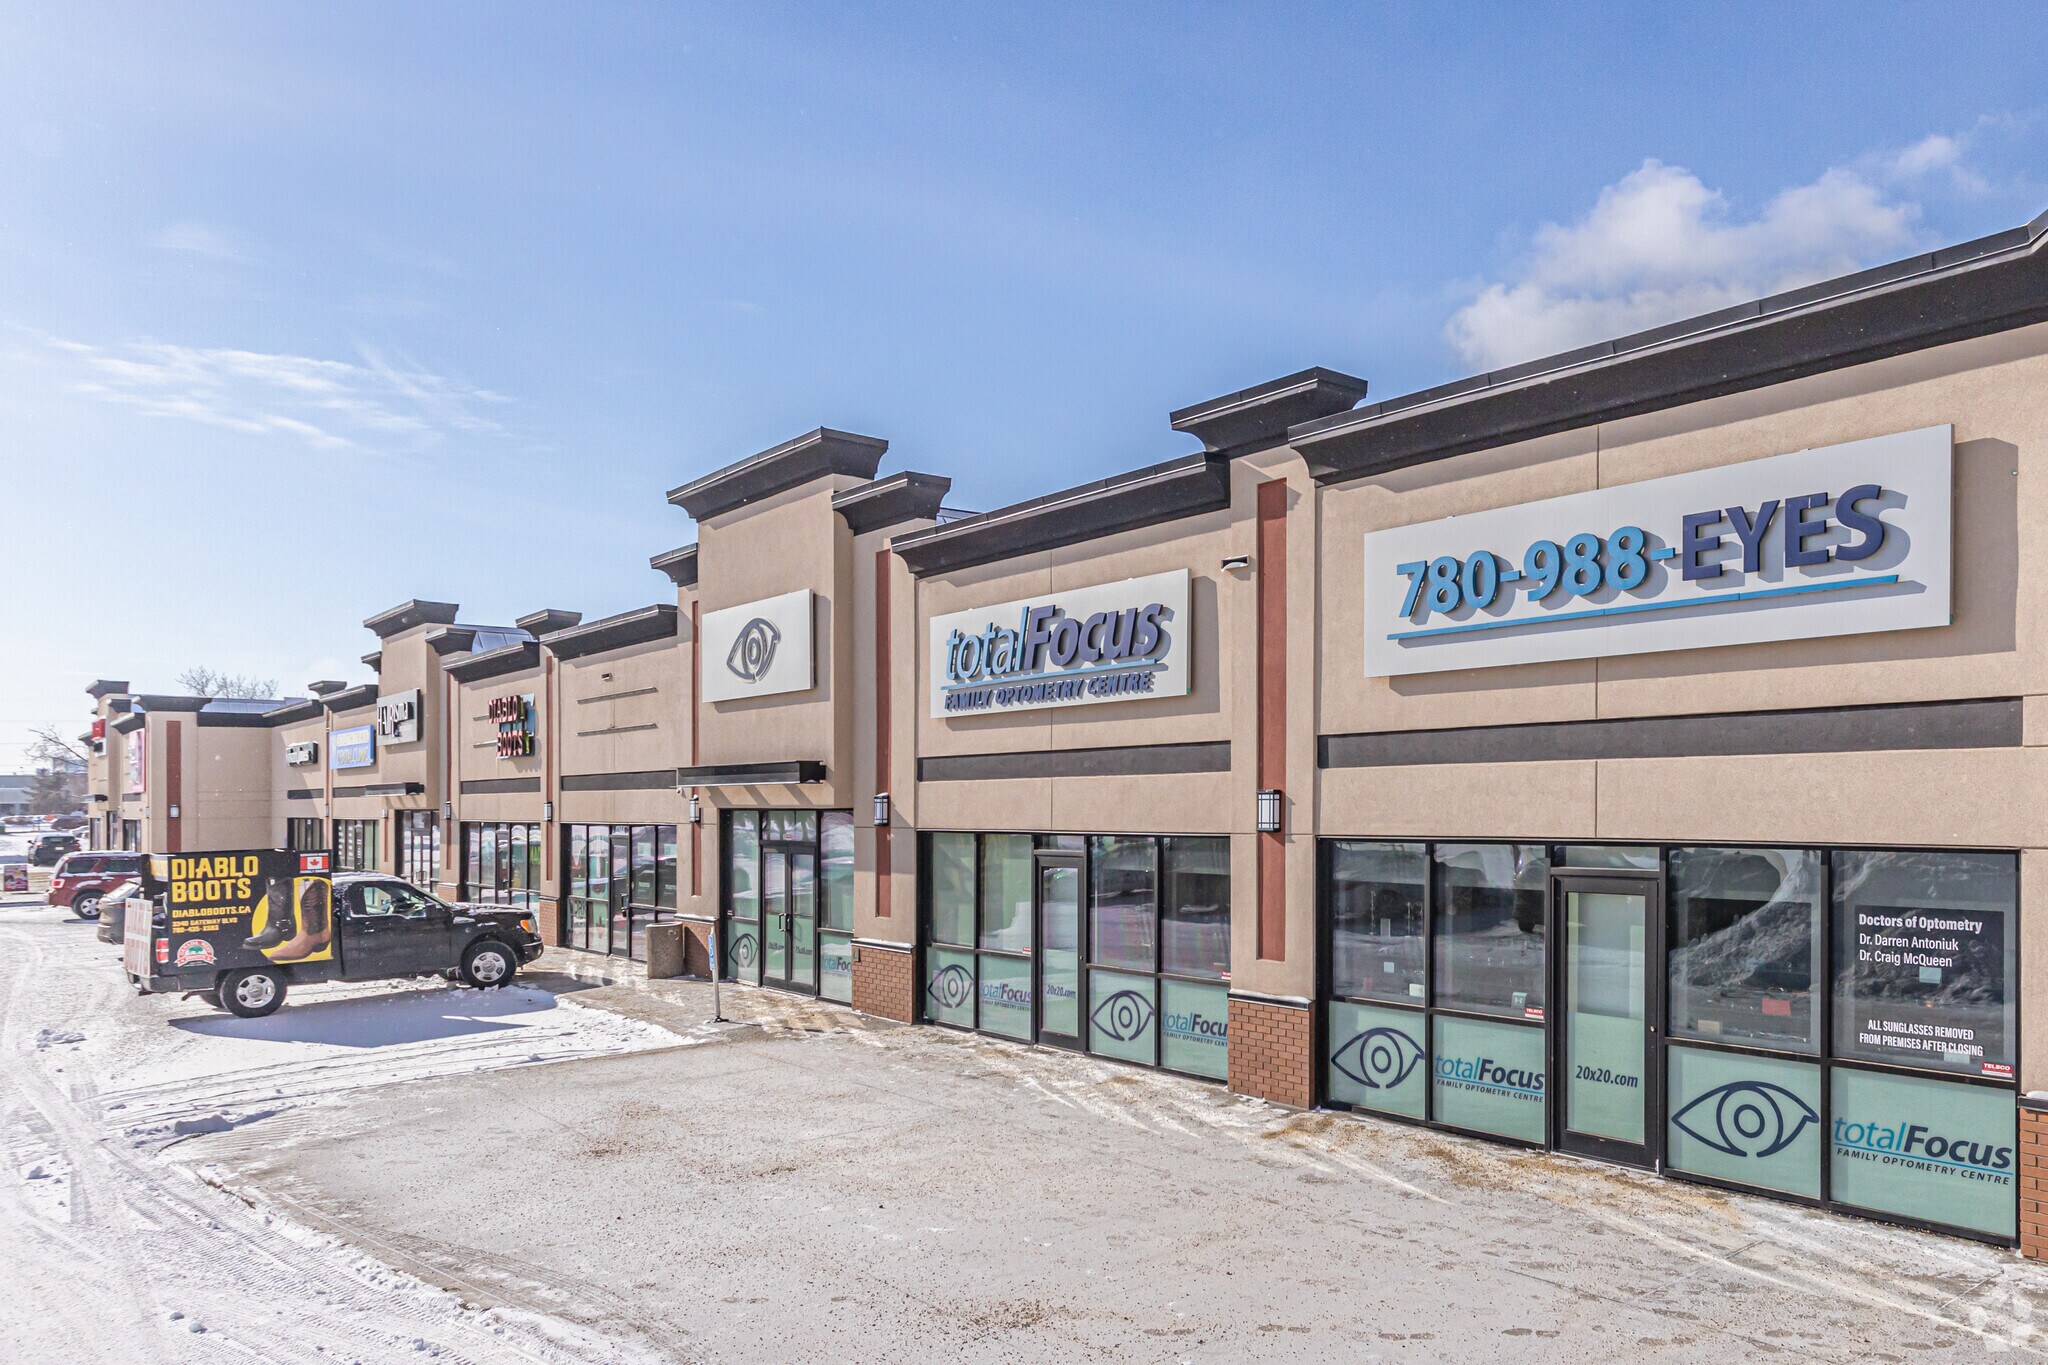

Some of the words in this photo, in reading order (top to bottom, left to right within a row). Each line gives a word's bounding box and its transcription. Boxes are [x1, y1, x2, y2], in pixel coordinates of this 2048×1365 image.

[1396, 484, 1882, 618] 780-988-EYES
[945, 603, 1163, 680] totalFocus
[945, 688, 991, 710] FAMILY
[996, 679, 1083, 705] OPTOMETRY
[1088, 671, 1151, 695] CENTRE
[488, 695, 518, 724] DIABLO
[496, 729, 523, 757] BOOTS
[171, 856, 259, 880] DIABLO
[171, 878, 252, 903] BOOTS
[172, 905, 252, 918] DIABLOBOOTS.CA
[1858, 913, 1903, 928] Doctors
[1905, 915, 1918, 928] of
[1919, 917, 1983, 935] Optometry
[1859, 933, 1873, 945] Dr.
[1874, 934, 1909, 948] Darren
[1911, 936, 1959, 951] Antoniuk
[822, 956, 852, 973] otalFoc
[1859, 949, 1873, 961] Dr.
[1874, 950, 1901, 966] Craig
[1903, 953, 1953, 967] McQueen
[1046, 984, 1077, 999] 20x20.com
[1162, 1011, 1228, 1037] totalFocu
[1867, 1019, 1882, 1032] ALL
[1883, 1020, 1934, 1037] SUNGLASSES
[1935, 1026, 1974, 1040] REMOVED
[1163, 1031, 1181, 1039] FAMILY
[1182, 1034, 1213, 1045] OPTOMETRY
[1859, 1032, 1881, 1045] FROM
[1882, 1035, 1921, 1050] PREMISES
[1922, 1039, 1947, 1053] AFTER
[1948, 1042, 1984, 1057] CLOSING
[1435, 1054, 1545, 1091] totalFocus
[1575, 1065, 1639, 1088] 20x20.com
[1436, 1078, 1463, 1091] FAMILY
[1465, 1083, 1511, 1098] OPTOMETRY
[1513, 1092, 1544, 1103] CENTRE
[1833, 1116, 2013, 1169] totalFocus
[1836, 1147, 1879, 1162] FAMILY
[1882, 1155, 1956, 1176] OPTOMETRY
[1961, 1169, 2010, 1186] CENTRE
